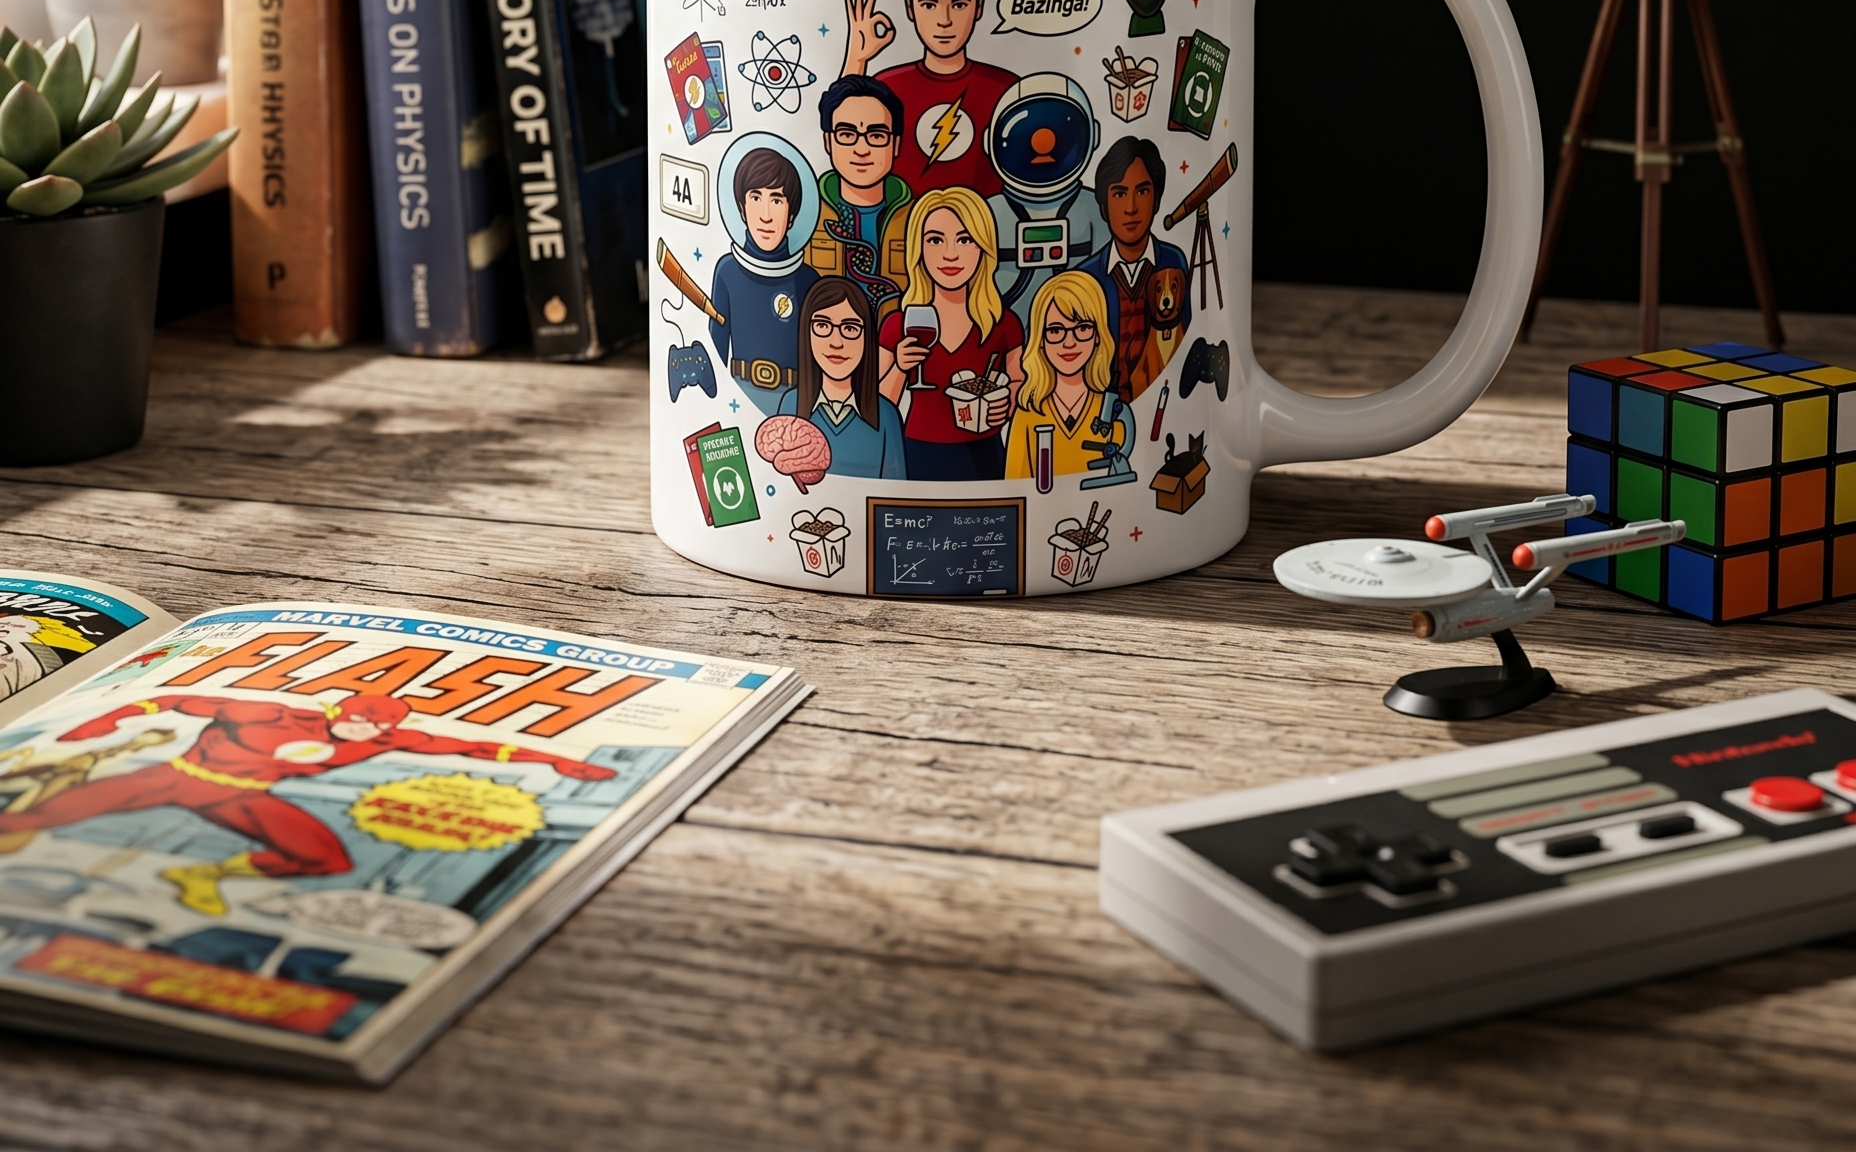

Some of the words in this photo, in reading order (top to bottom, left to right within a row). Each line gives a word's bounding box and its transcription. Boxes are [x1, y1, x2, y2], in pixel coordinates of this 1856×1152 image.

[387, 23, 421, 74] ON
[510, 84, 551, 145] OF
[391, 82, 431, 231] PHYSICS
[519, 151, 567, 262] TIME
[672, 175, 693, 206] 4A
[271, 611, 405, 632] MARVEL
[415, 621, 548, 653] COMICS
[555, 644, 676, 672] GROUP
[157, 631, 666, 739] FLASH
